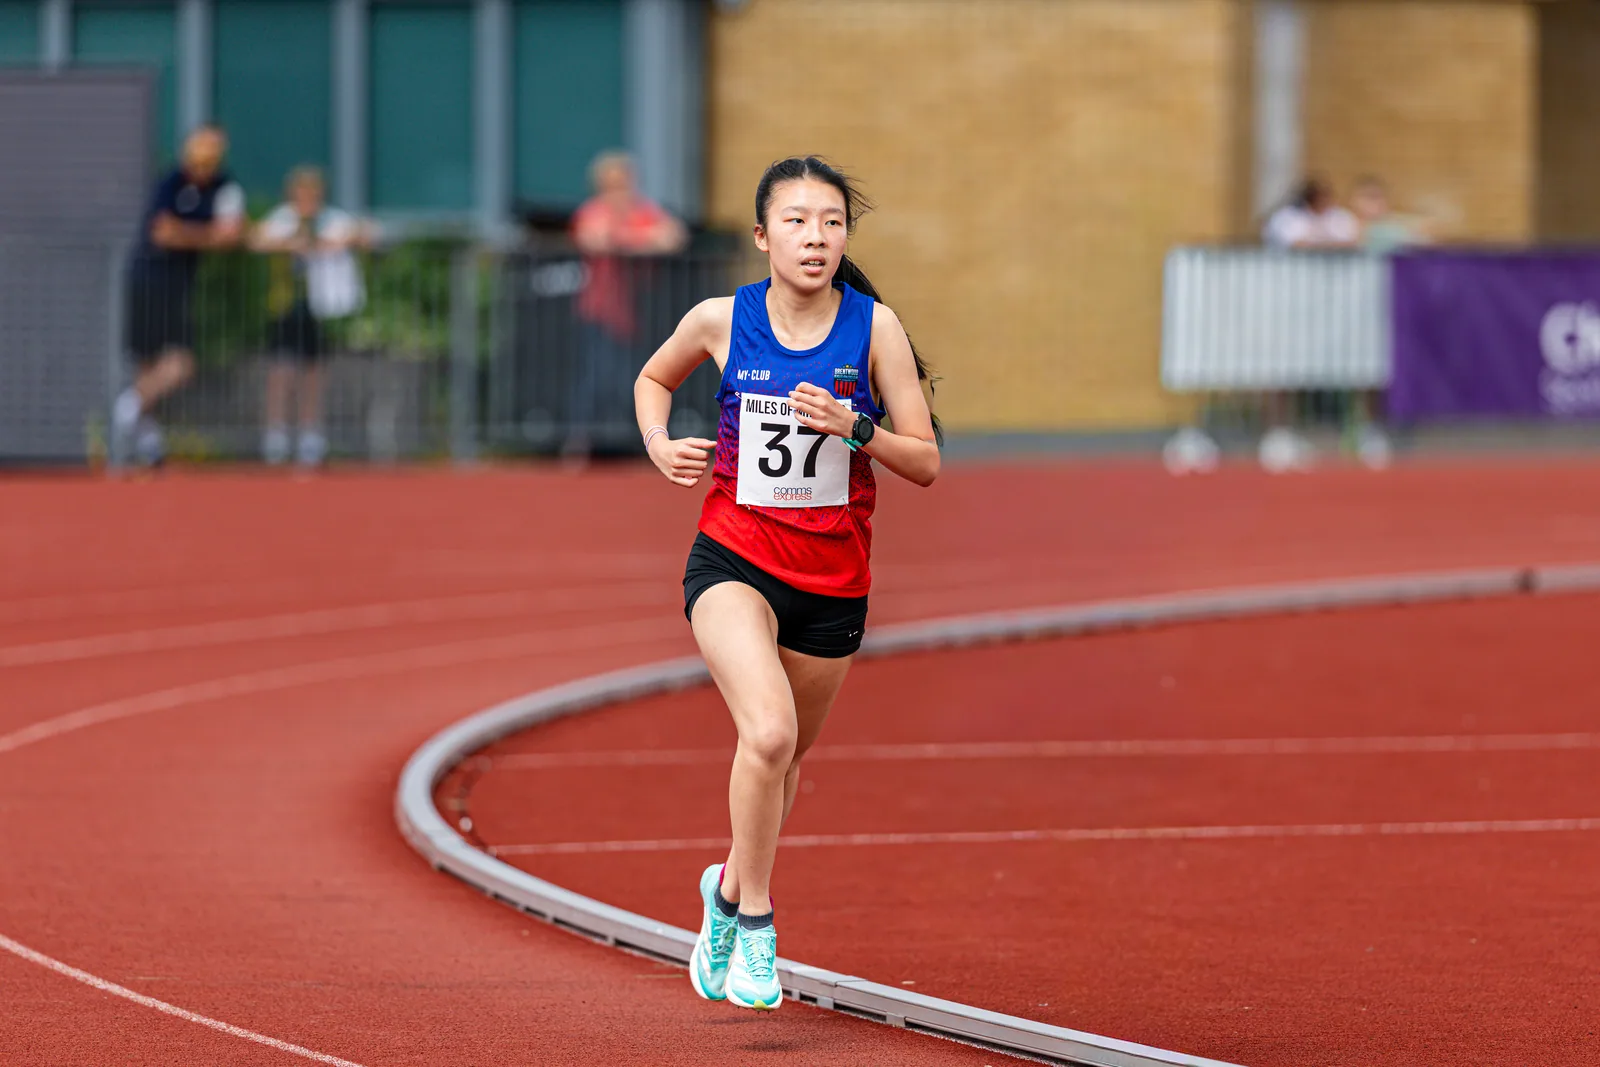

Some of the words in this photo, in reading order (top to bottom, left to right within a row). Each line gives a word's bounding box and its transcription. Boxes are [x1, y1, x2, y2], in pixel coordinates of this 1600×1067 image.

[745, 399, 777, 415] MILES
[758, 422, 830, 478] 37
[773, 486, 812, 495] comms
[773, 493, 812, 501] express
